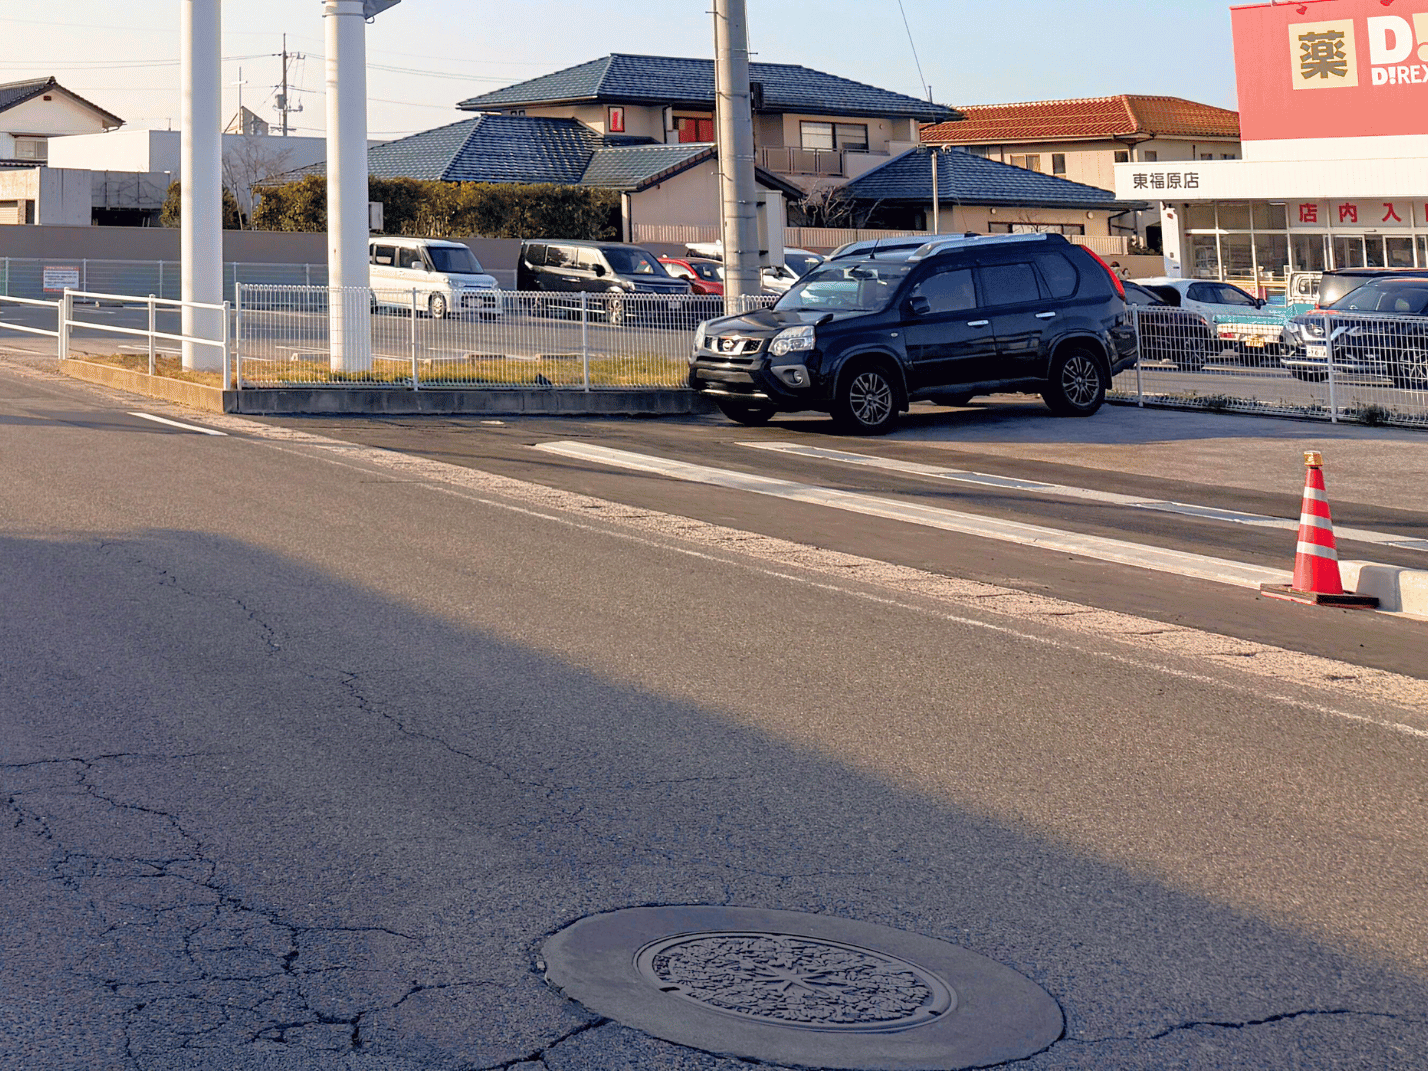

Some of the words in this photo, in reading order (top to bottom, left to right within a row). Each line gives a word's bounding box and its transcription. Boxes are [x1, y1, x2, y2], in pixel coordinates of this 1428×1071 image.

[1298, 30, 1348, 80] 薬
[1133, 172, 1200, 189] 東福原店
[1299, 202, 1428, 224] 店内入
